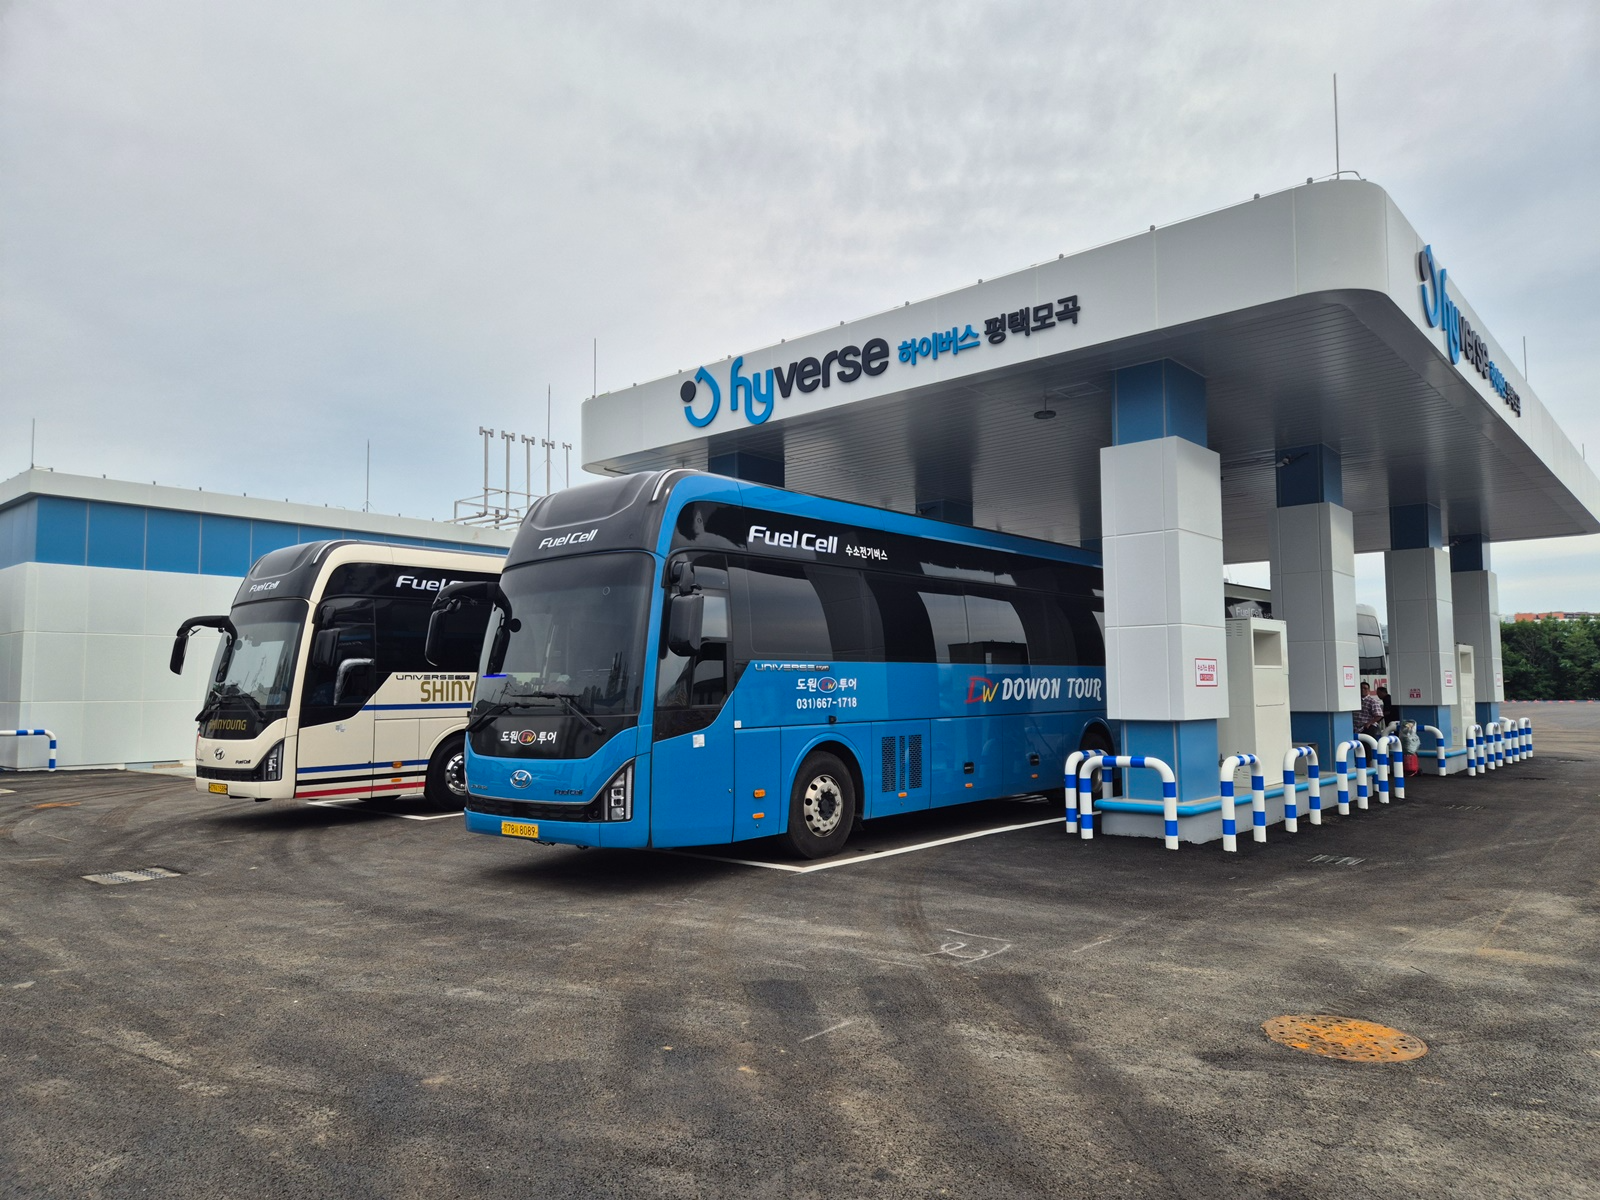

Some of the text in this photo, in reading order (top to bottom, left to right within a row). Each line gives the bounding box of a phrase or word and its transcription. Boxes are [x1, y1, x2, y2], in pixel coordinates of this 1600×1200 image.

[730, 295, 1081, 424] hyverse 하이버스 평택모곡
[538, 529, 599, 549] Fuel Cell
[748, 525, 888, 560] Fuel Cell 수소전기버스
[249, 580, 280, 593] Fuel Cell
[395, 575, 446, 591] Fuel
[755, 663, 815, 671] UNIVERSE
[796, 678, 817, 692] 도원
[839, 678, 857, 691] 투어
[1002, 677, 1061, 701] DOWON
[1067, 677, 1102, 702] TOUR
[796, 697, 857, 709] 031)667-1718
[501, 731, 518, 744] 도원
[537, 731, 557, 744] 투어
